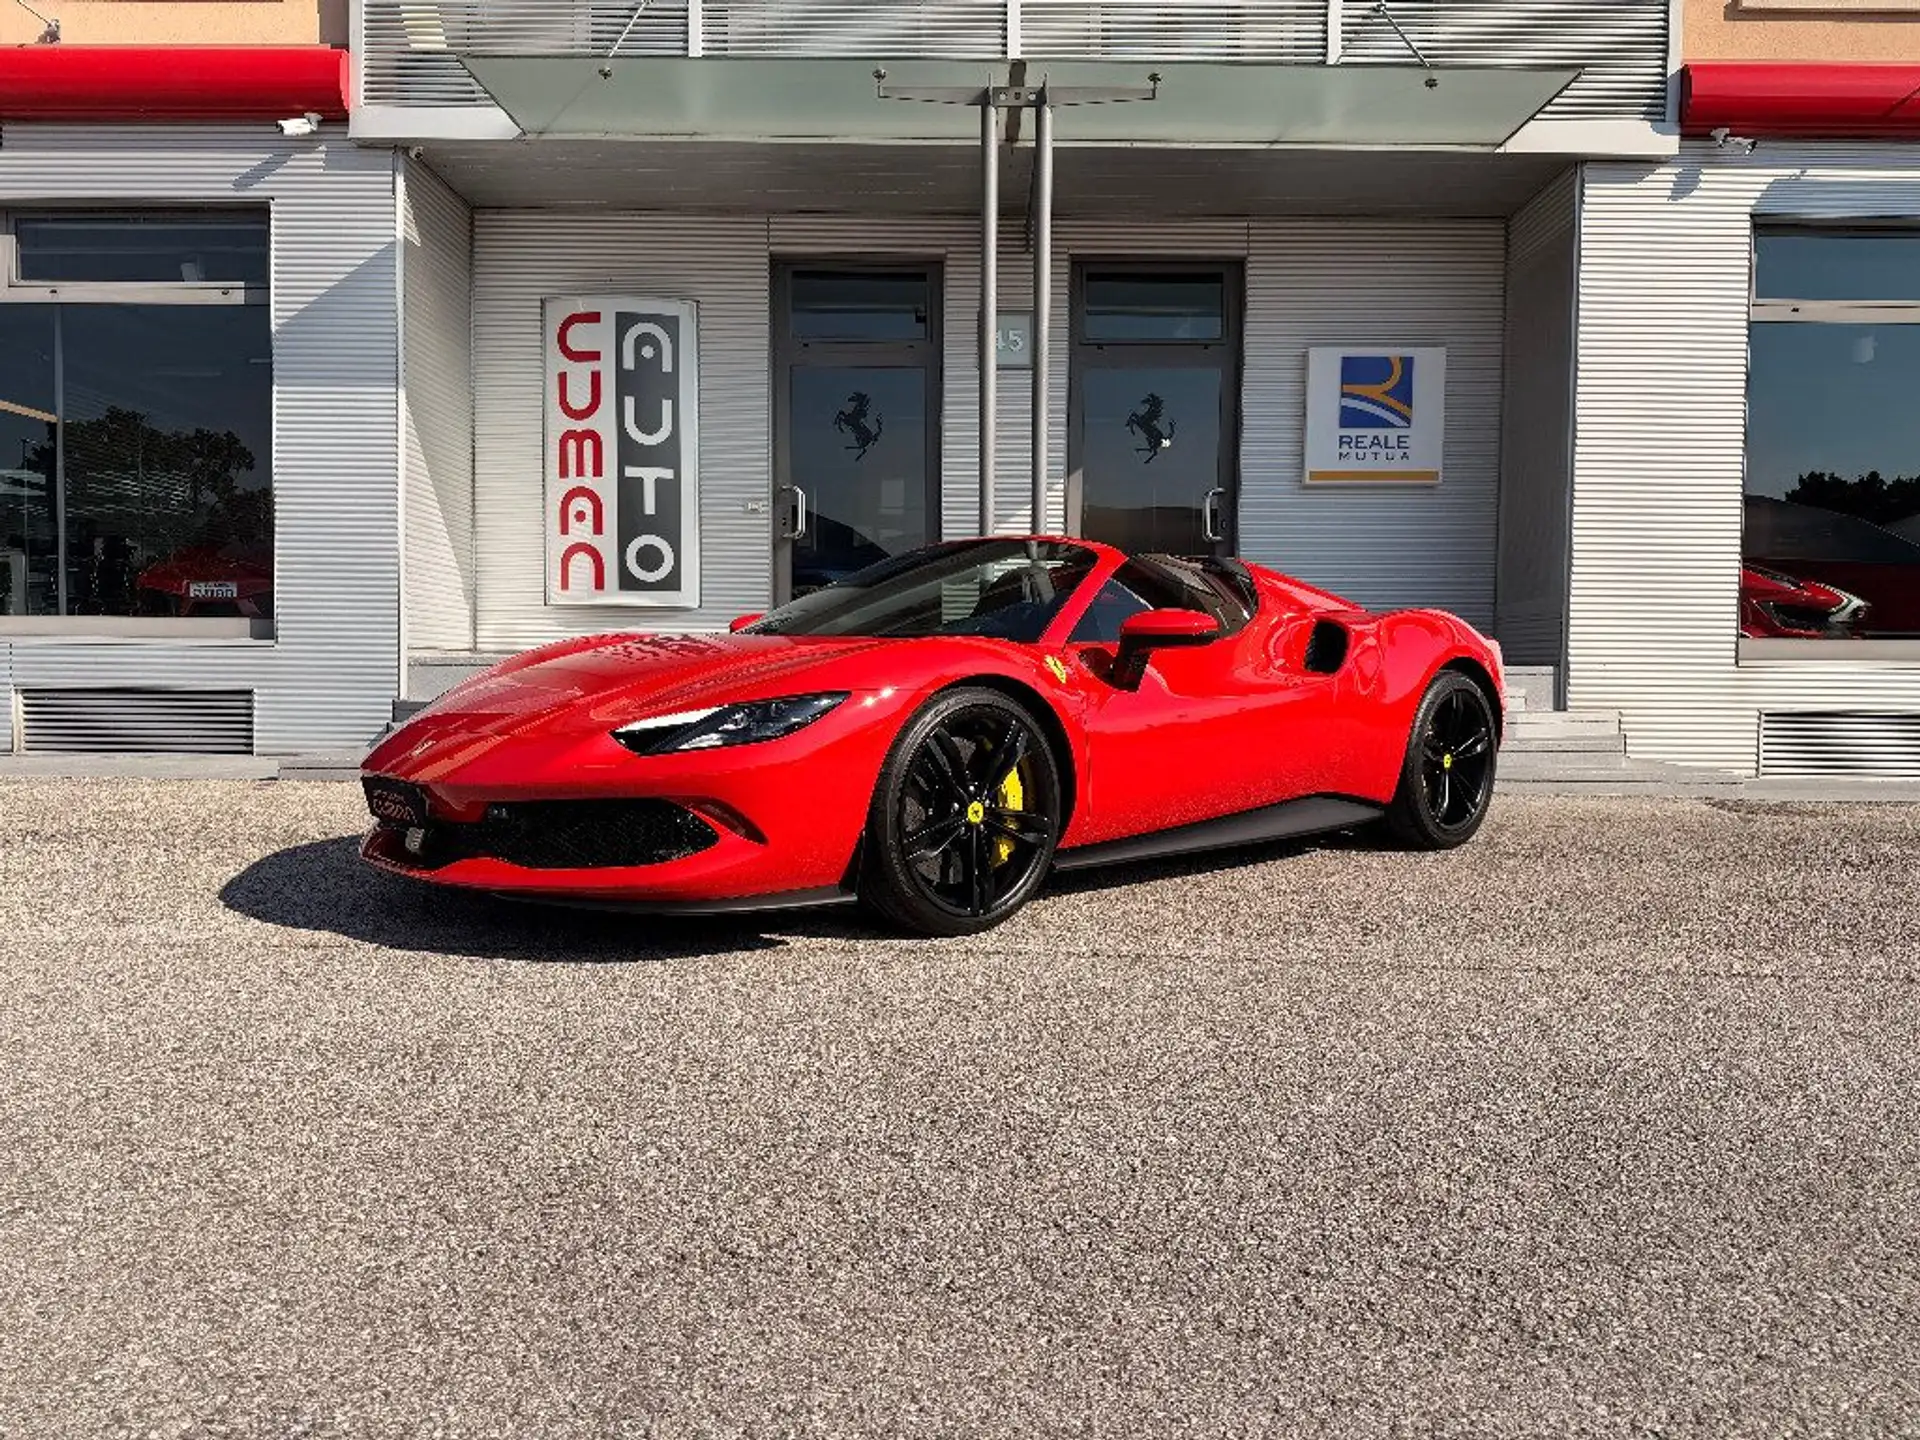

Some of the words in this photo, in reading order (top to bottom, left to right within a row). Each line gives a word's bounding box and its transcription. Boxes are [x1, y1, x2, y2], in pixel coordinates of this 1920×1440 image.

[557, 311, 605, 591] CUMAN
[622, 322, 675, 583] AUTO
[1338, 435, 1410, 449] REALE
[1338, 451, 1410, 461] MUTUA
